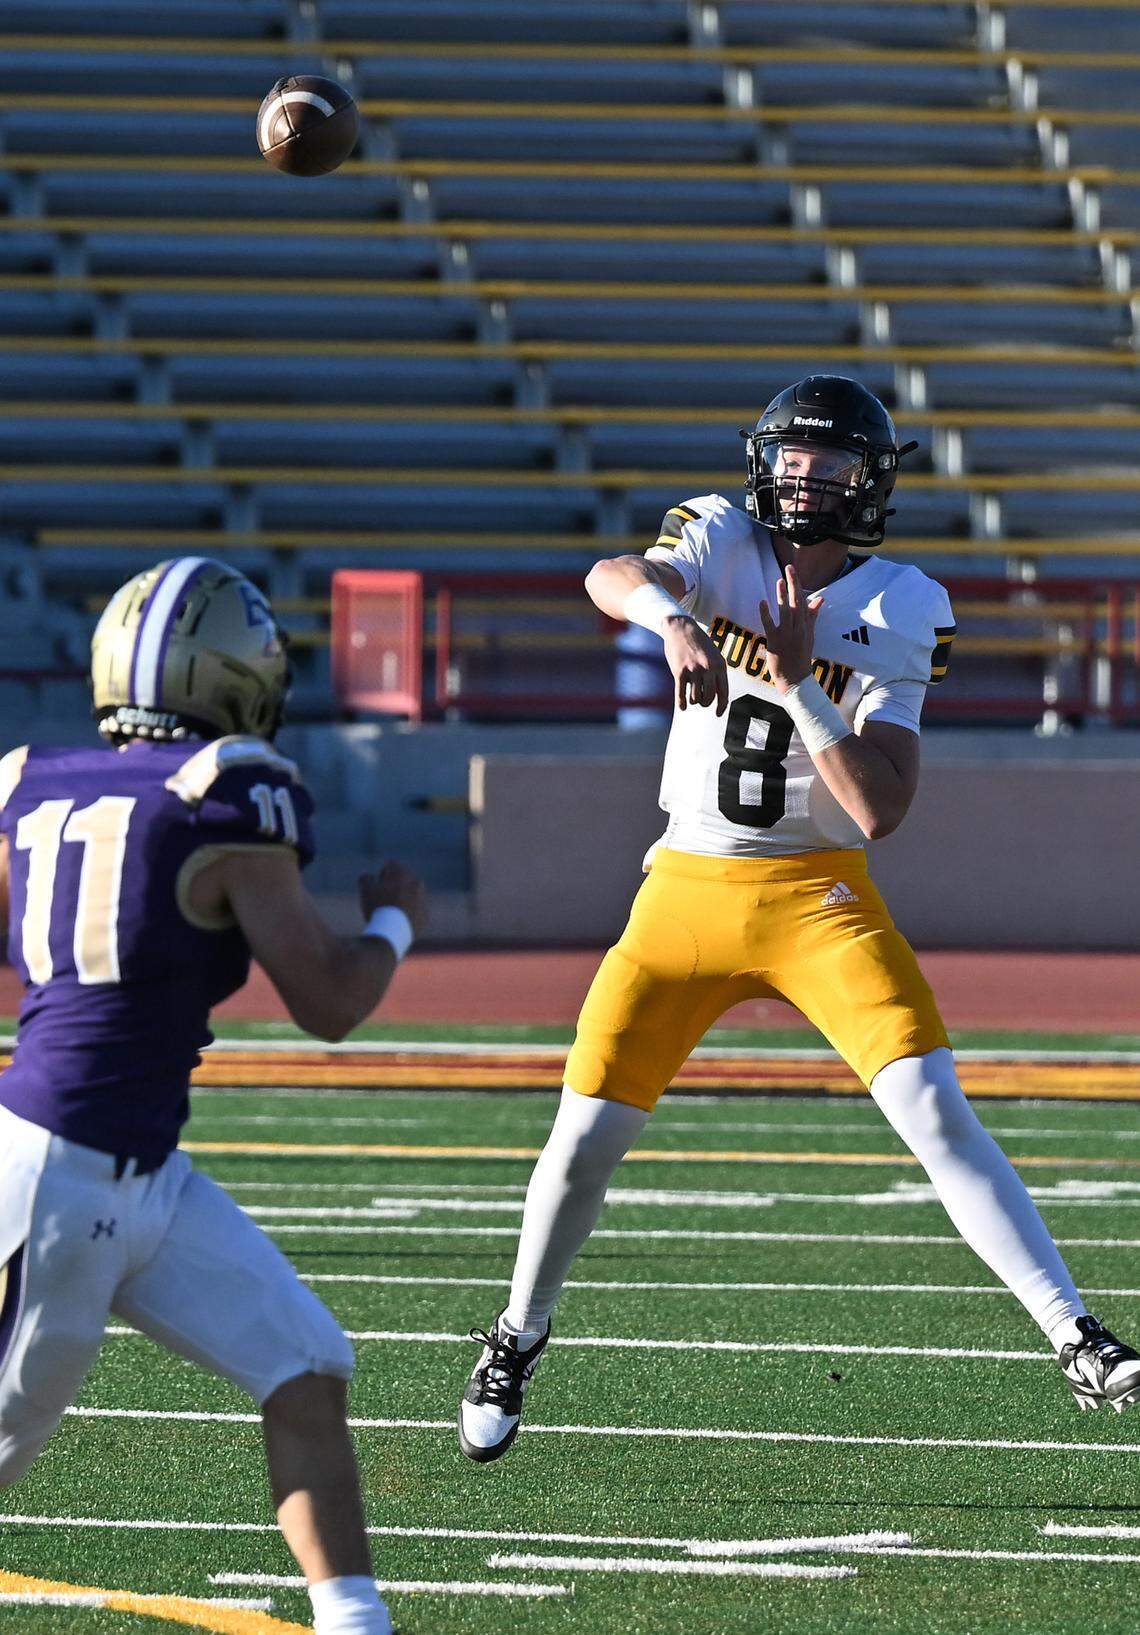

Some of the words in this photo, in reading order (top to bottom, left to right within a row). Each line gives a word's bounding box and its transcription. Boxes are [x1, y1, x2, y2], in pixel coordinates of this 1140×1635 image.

[793, 416, 833, 428] Riddell
[709, 616, 854, 705] HUGON
[718, 694, 795, 828] 8
[249, 784, 299, 842] 11
[16, 796, 137, 985] 11
[820, 894, 860, 906] adidas
